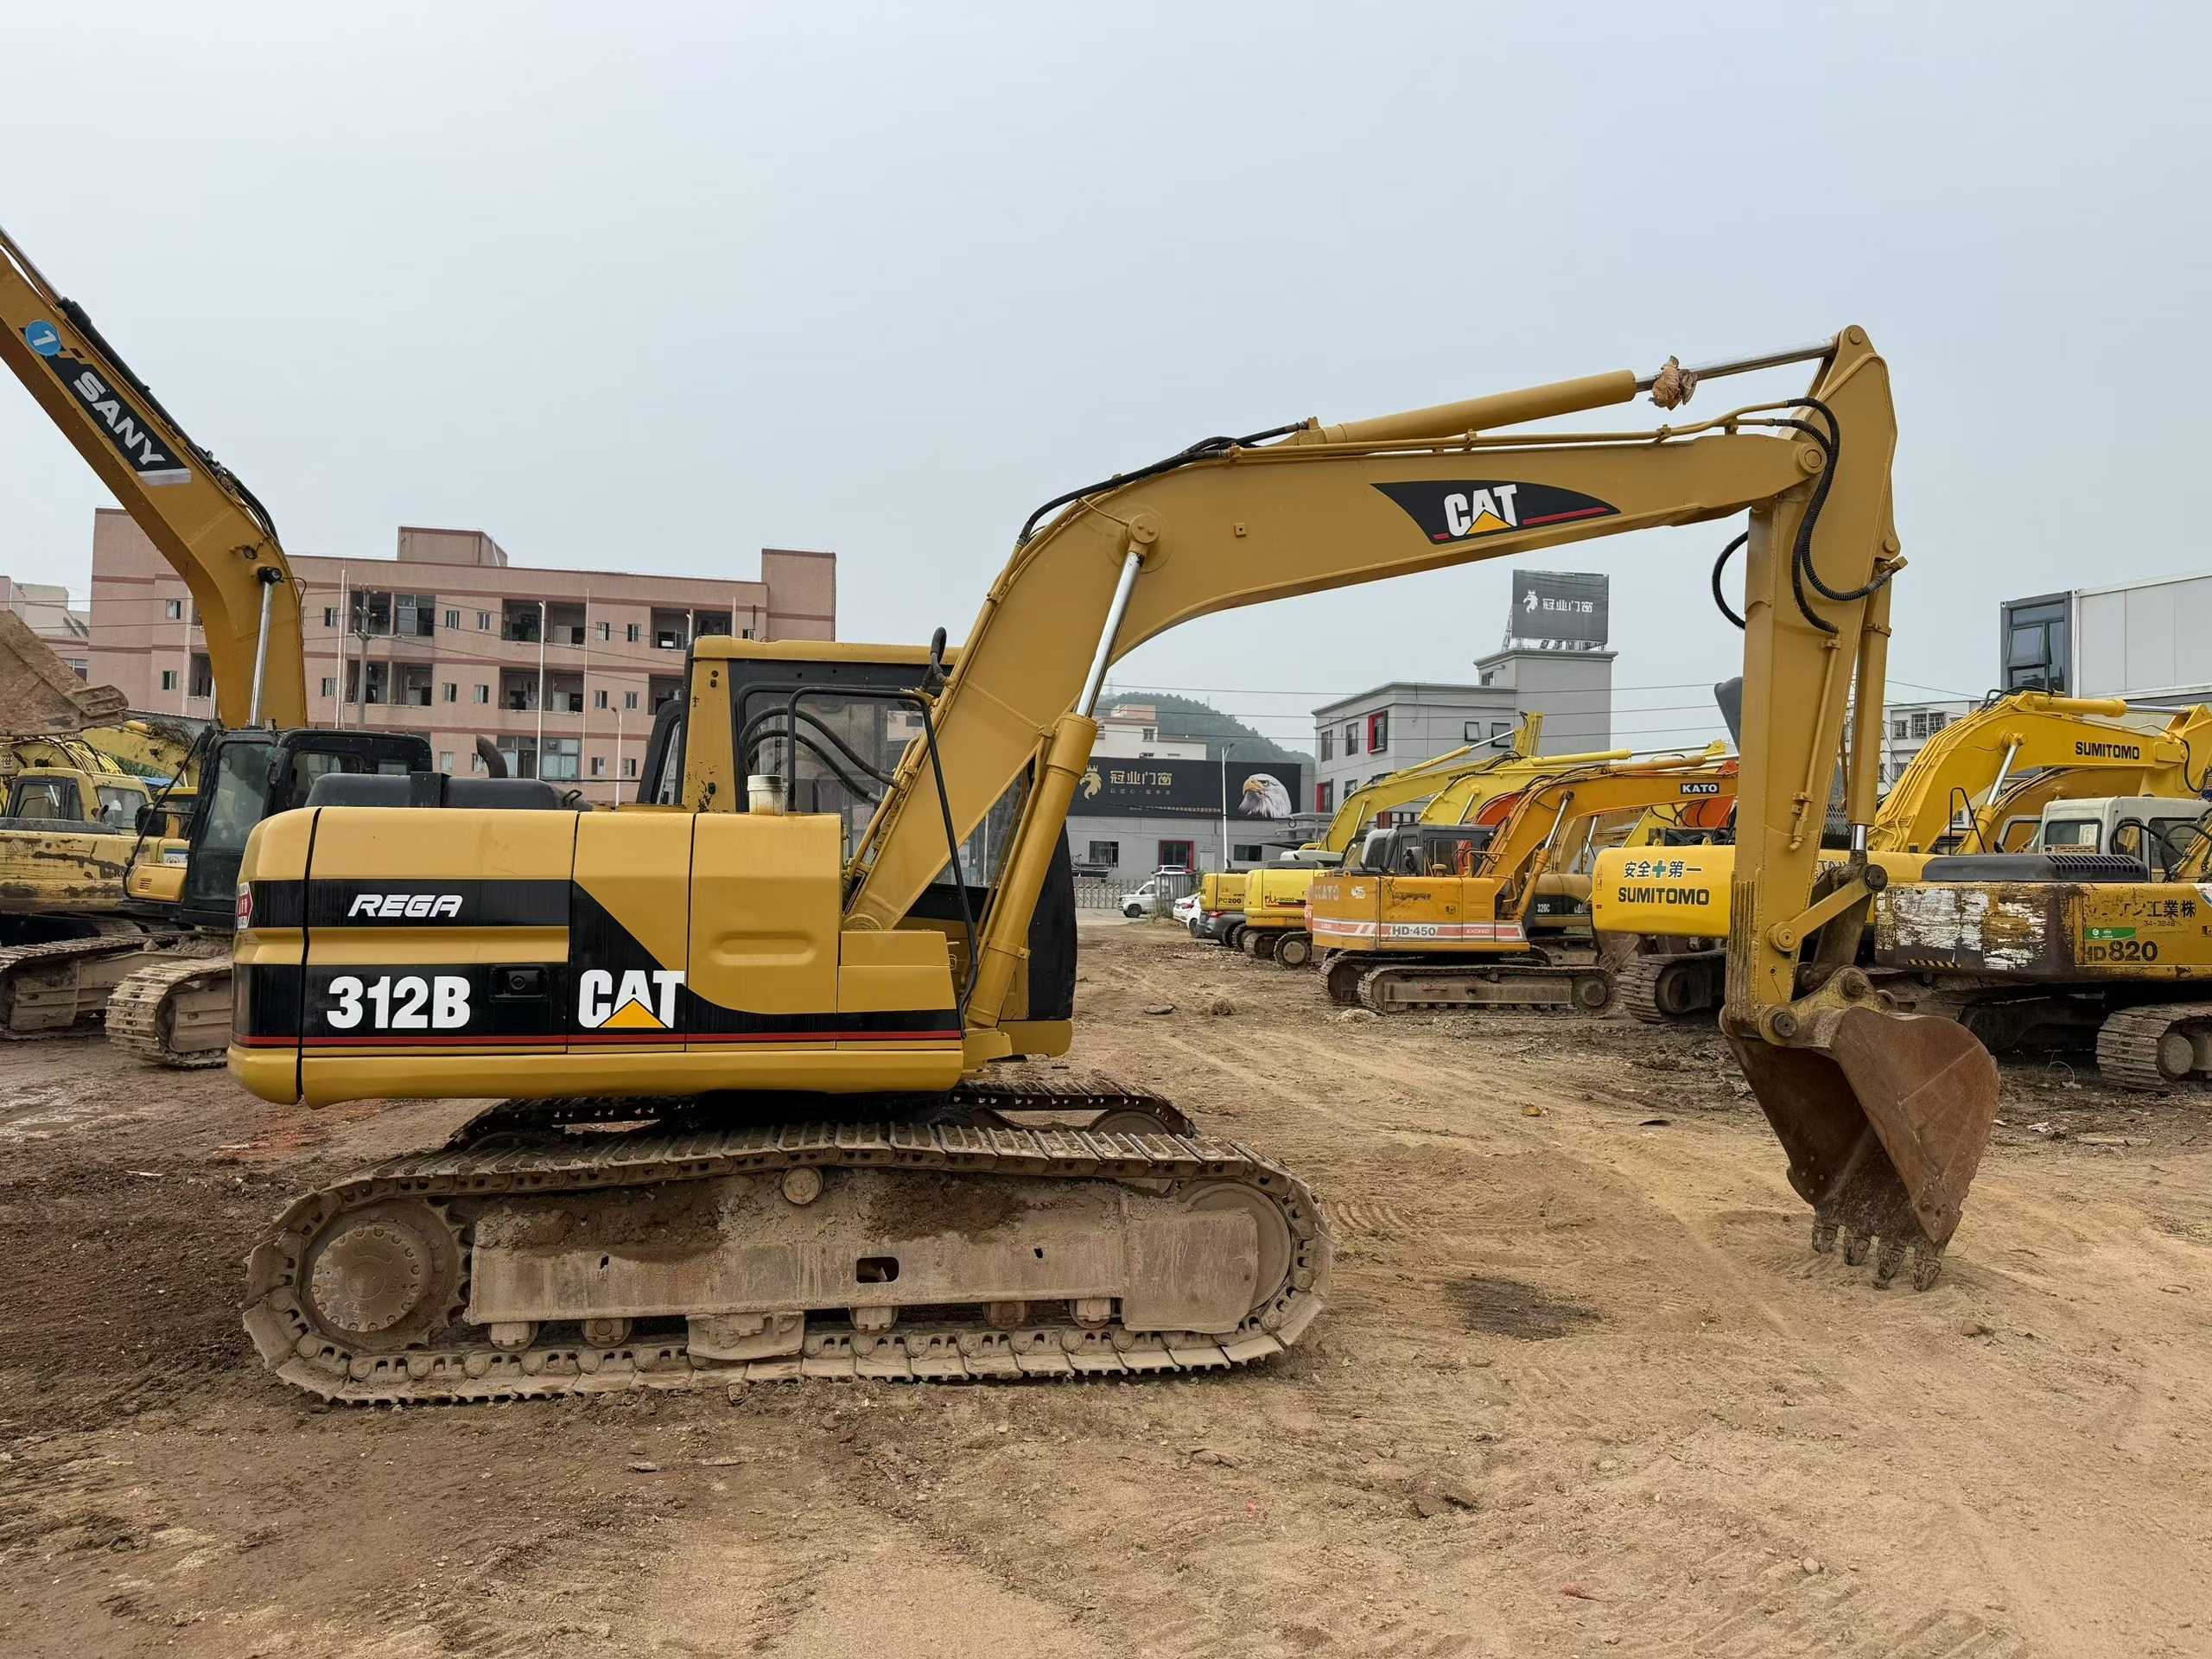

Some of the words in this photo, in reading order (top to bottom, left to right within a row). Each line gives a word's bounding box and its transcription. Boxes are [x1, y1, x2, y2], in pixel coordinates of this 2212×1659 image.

[73, 371, 167, 466] SANY
[1444, 484, 1518, 537] CAT
[2075, 741, 2140, 760] SUMITOMO
[1109, 770, 1173, 785] 冠业门窗
[1681, 784, 1718, 793] KATO
[347, 893, 464, 918] REGA
[1217, 897, 1242, 906] PC200
[1618, 887, 1710, 906] SUMITOMO
[327, 976, 472, 1030] 312B
[578, 969, 685, 1029] CAT
